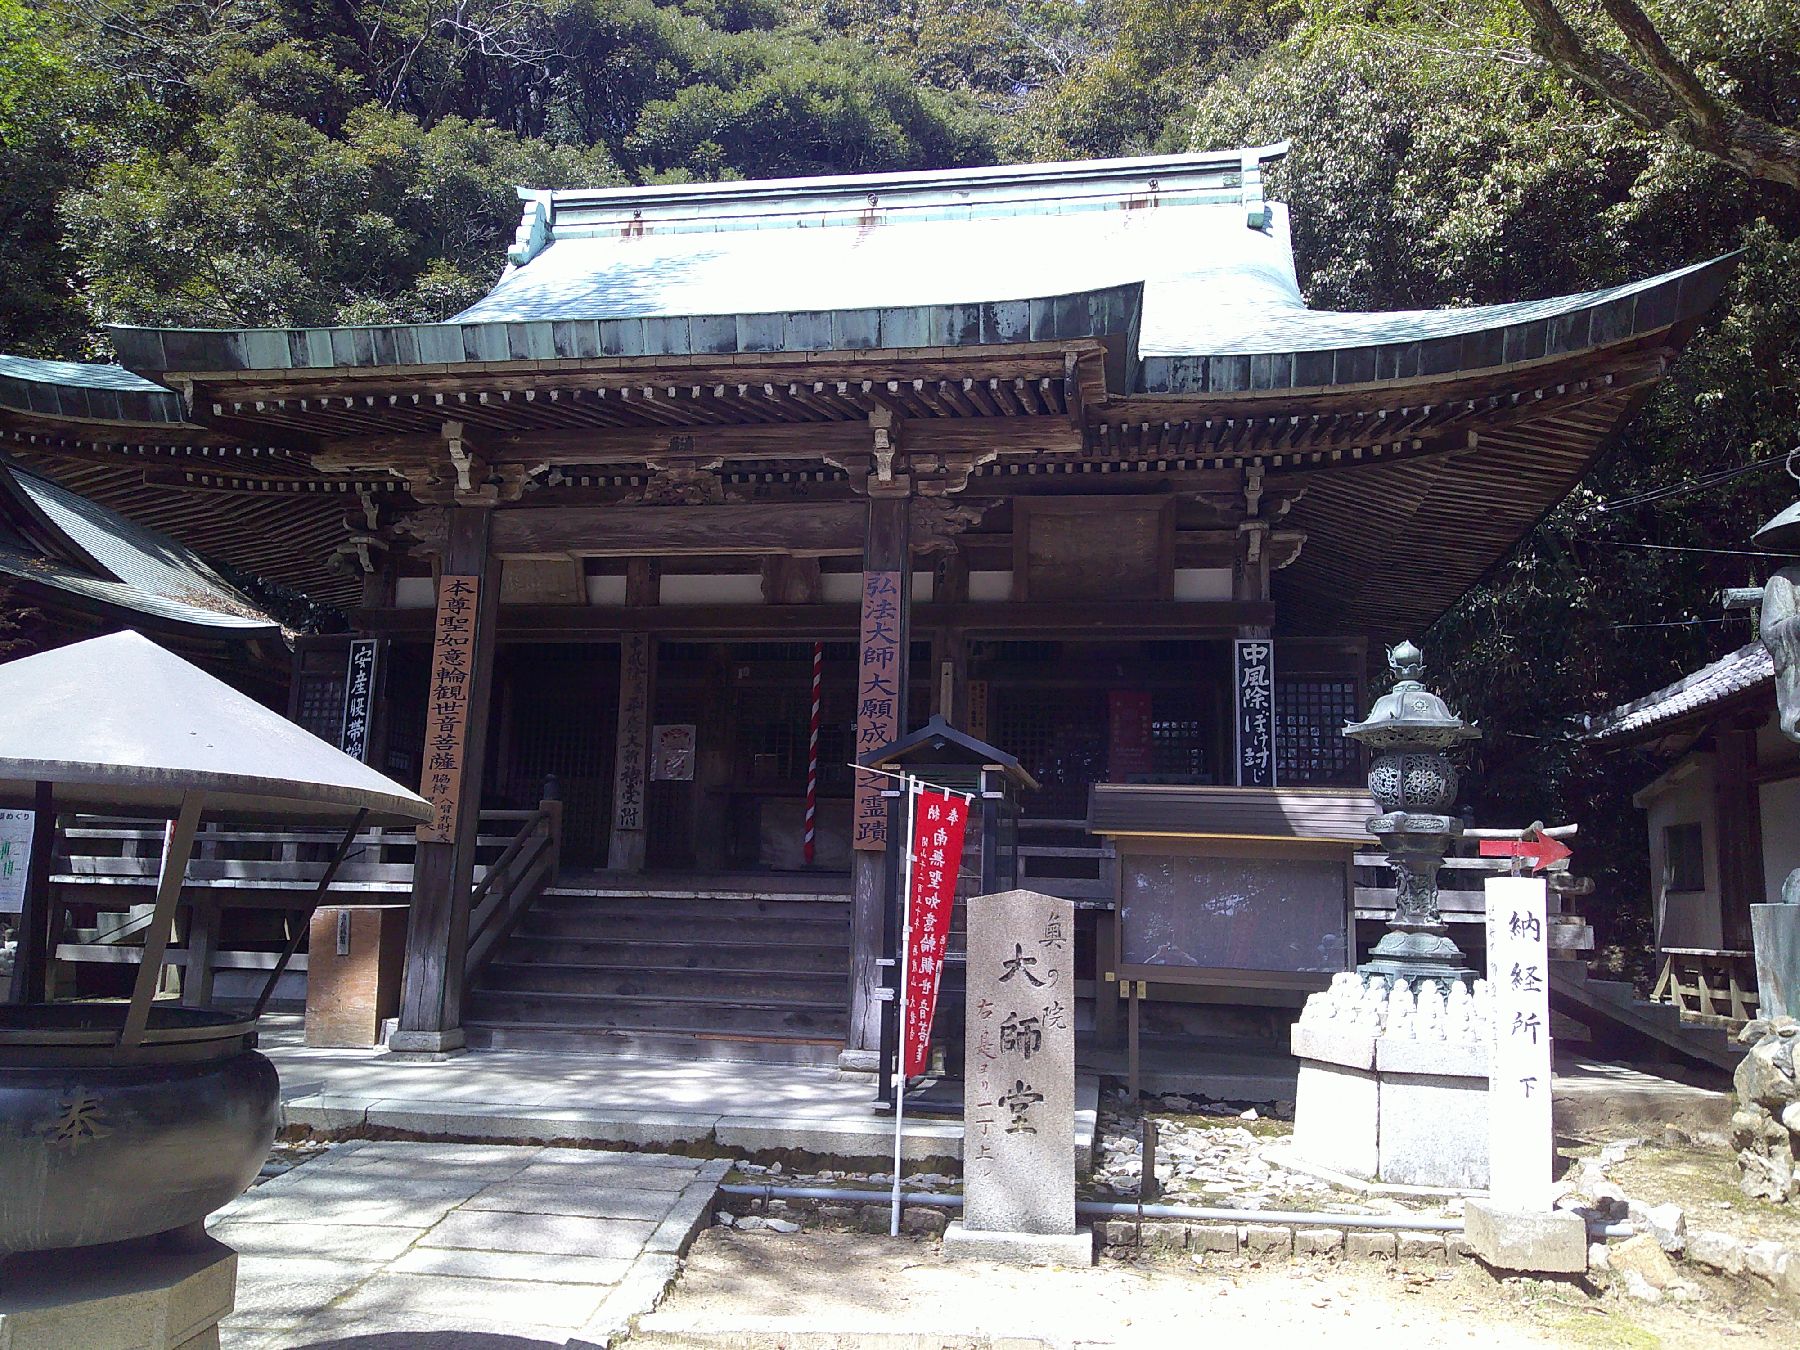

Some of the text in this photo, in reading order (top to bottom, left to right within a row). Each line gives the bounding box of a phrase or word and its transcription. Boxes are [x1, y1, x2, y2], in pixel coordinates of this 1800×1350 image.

[856, 573, 898, 844] 弘法大師大願成之霊蹟
[1241, 644, 1270, 783] 中風除ぼけ封じ
[998, 943, 1047, 1135] 大師堂
